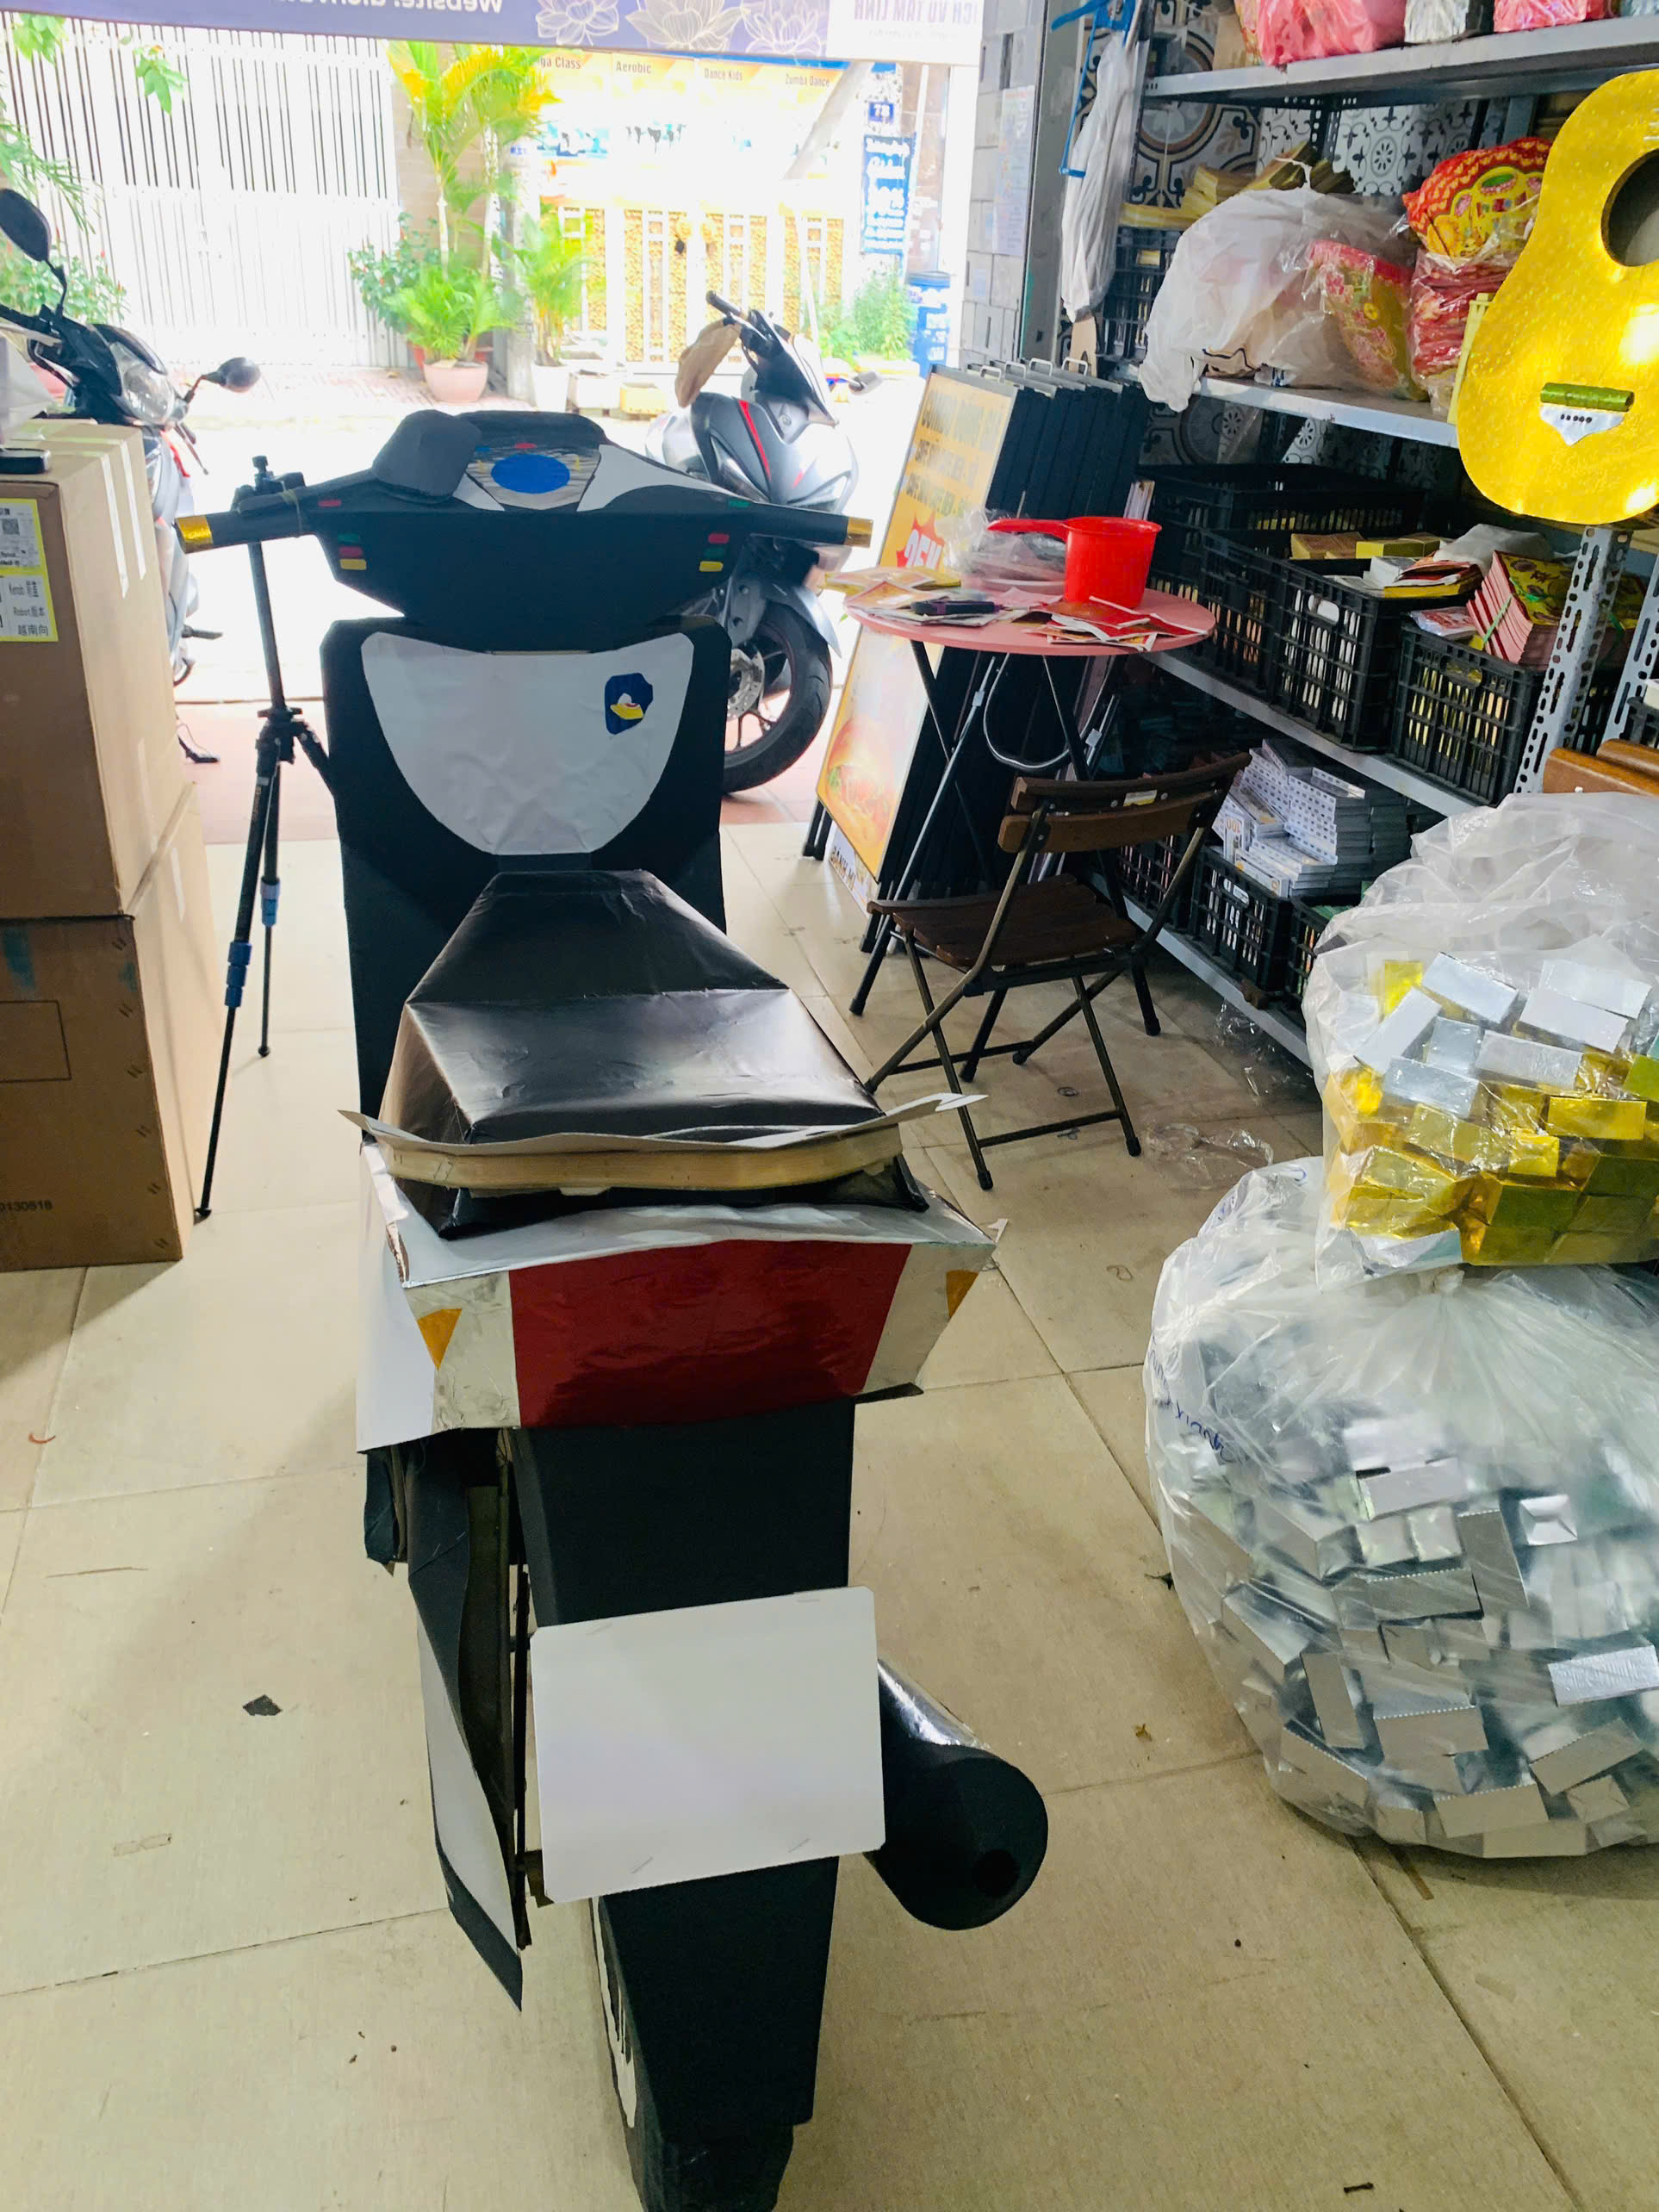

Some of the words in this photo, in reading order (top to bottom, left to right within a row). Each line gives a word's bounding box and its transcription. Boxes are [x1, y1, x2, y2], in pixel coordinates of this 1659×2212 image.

[555, 56, 581, 70] Class
[615, 60, 652, 75] Aerobic
[704, 67, 726, 80] Dance
[728, 69, 743, 82] Kids
[785, 73, 808, 86] Zumba
[809, 75, 830, 88] Dance
[17, 624, 49, 637] 越南向
